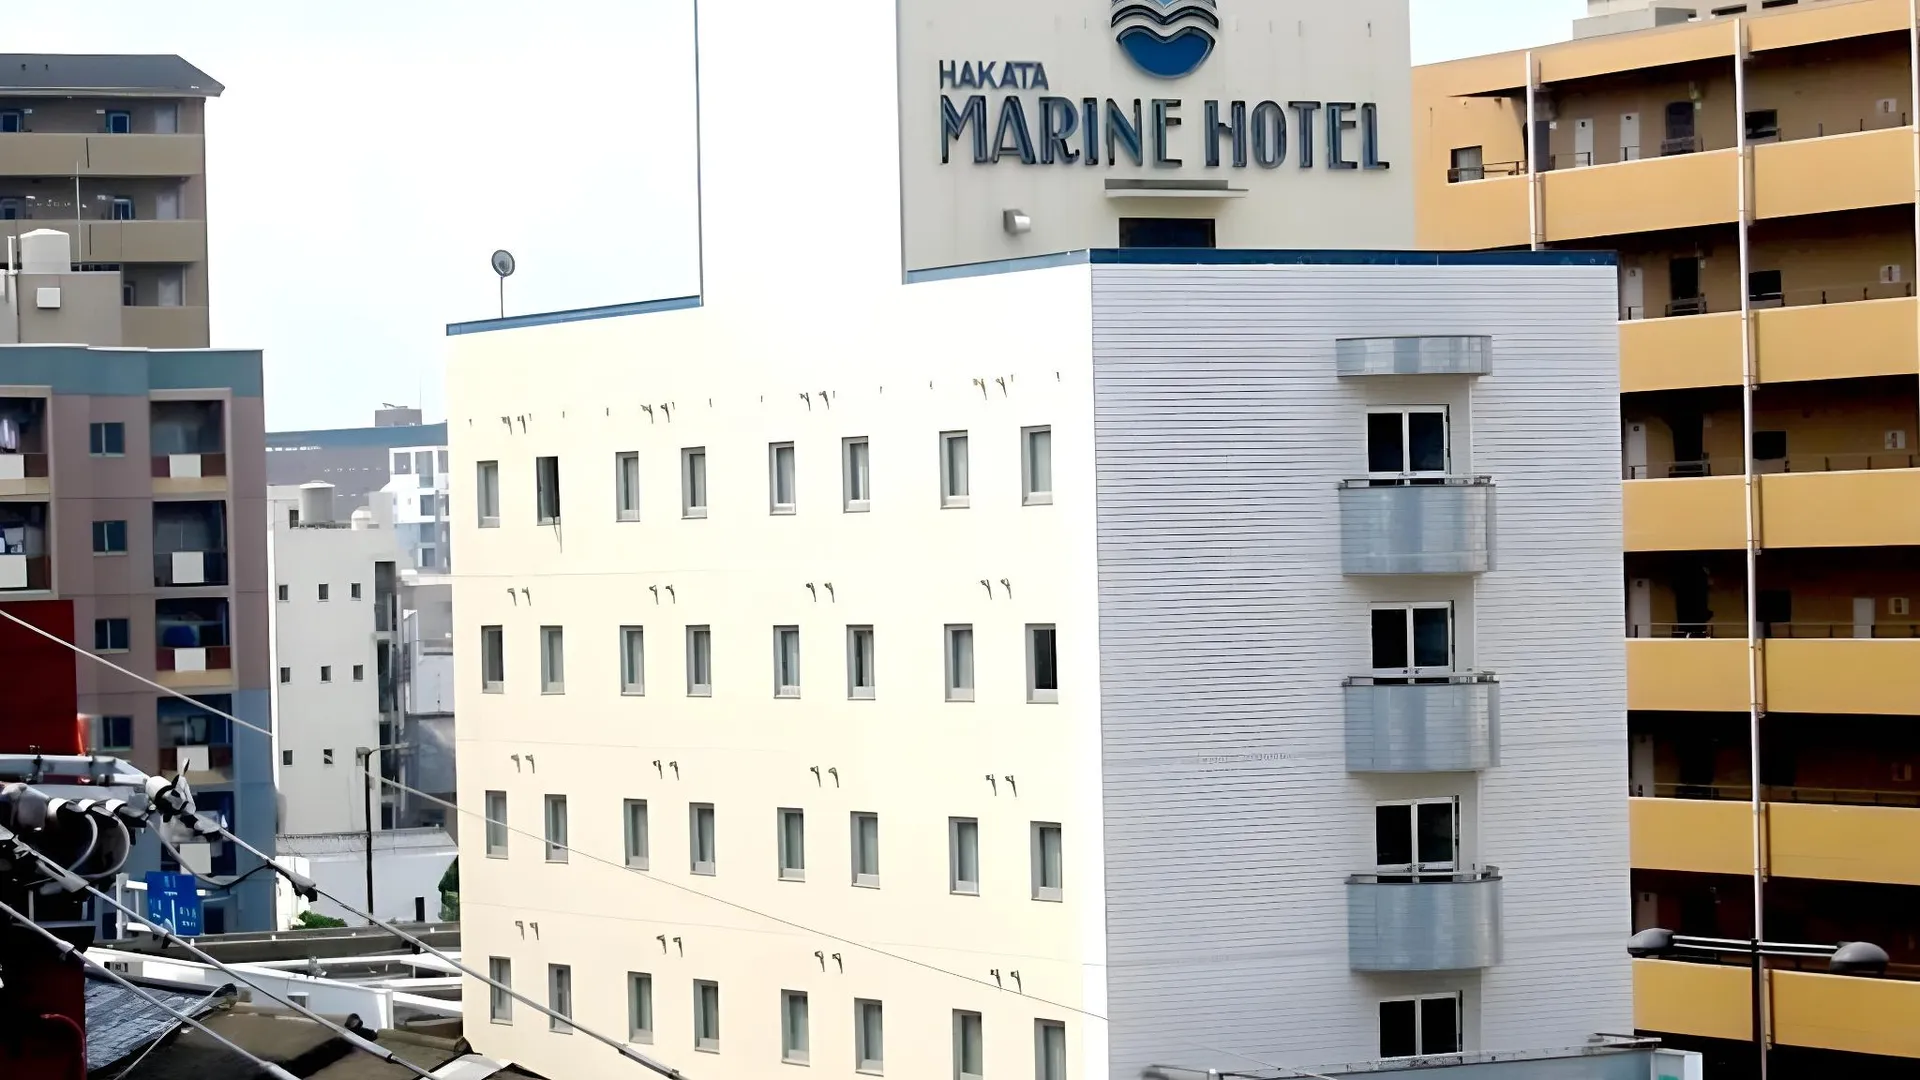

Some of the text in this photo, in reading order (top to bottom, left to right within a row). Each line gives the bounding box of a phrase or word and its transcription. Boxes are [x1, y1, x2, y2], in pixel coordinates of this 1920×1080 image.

[939, 60, 1049, 90] HAKATA
[940, 94, 1390, 170] MARINE HOTEL
